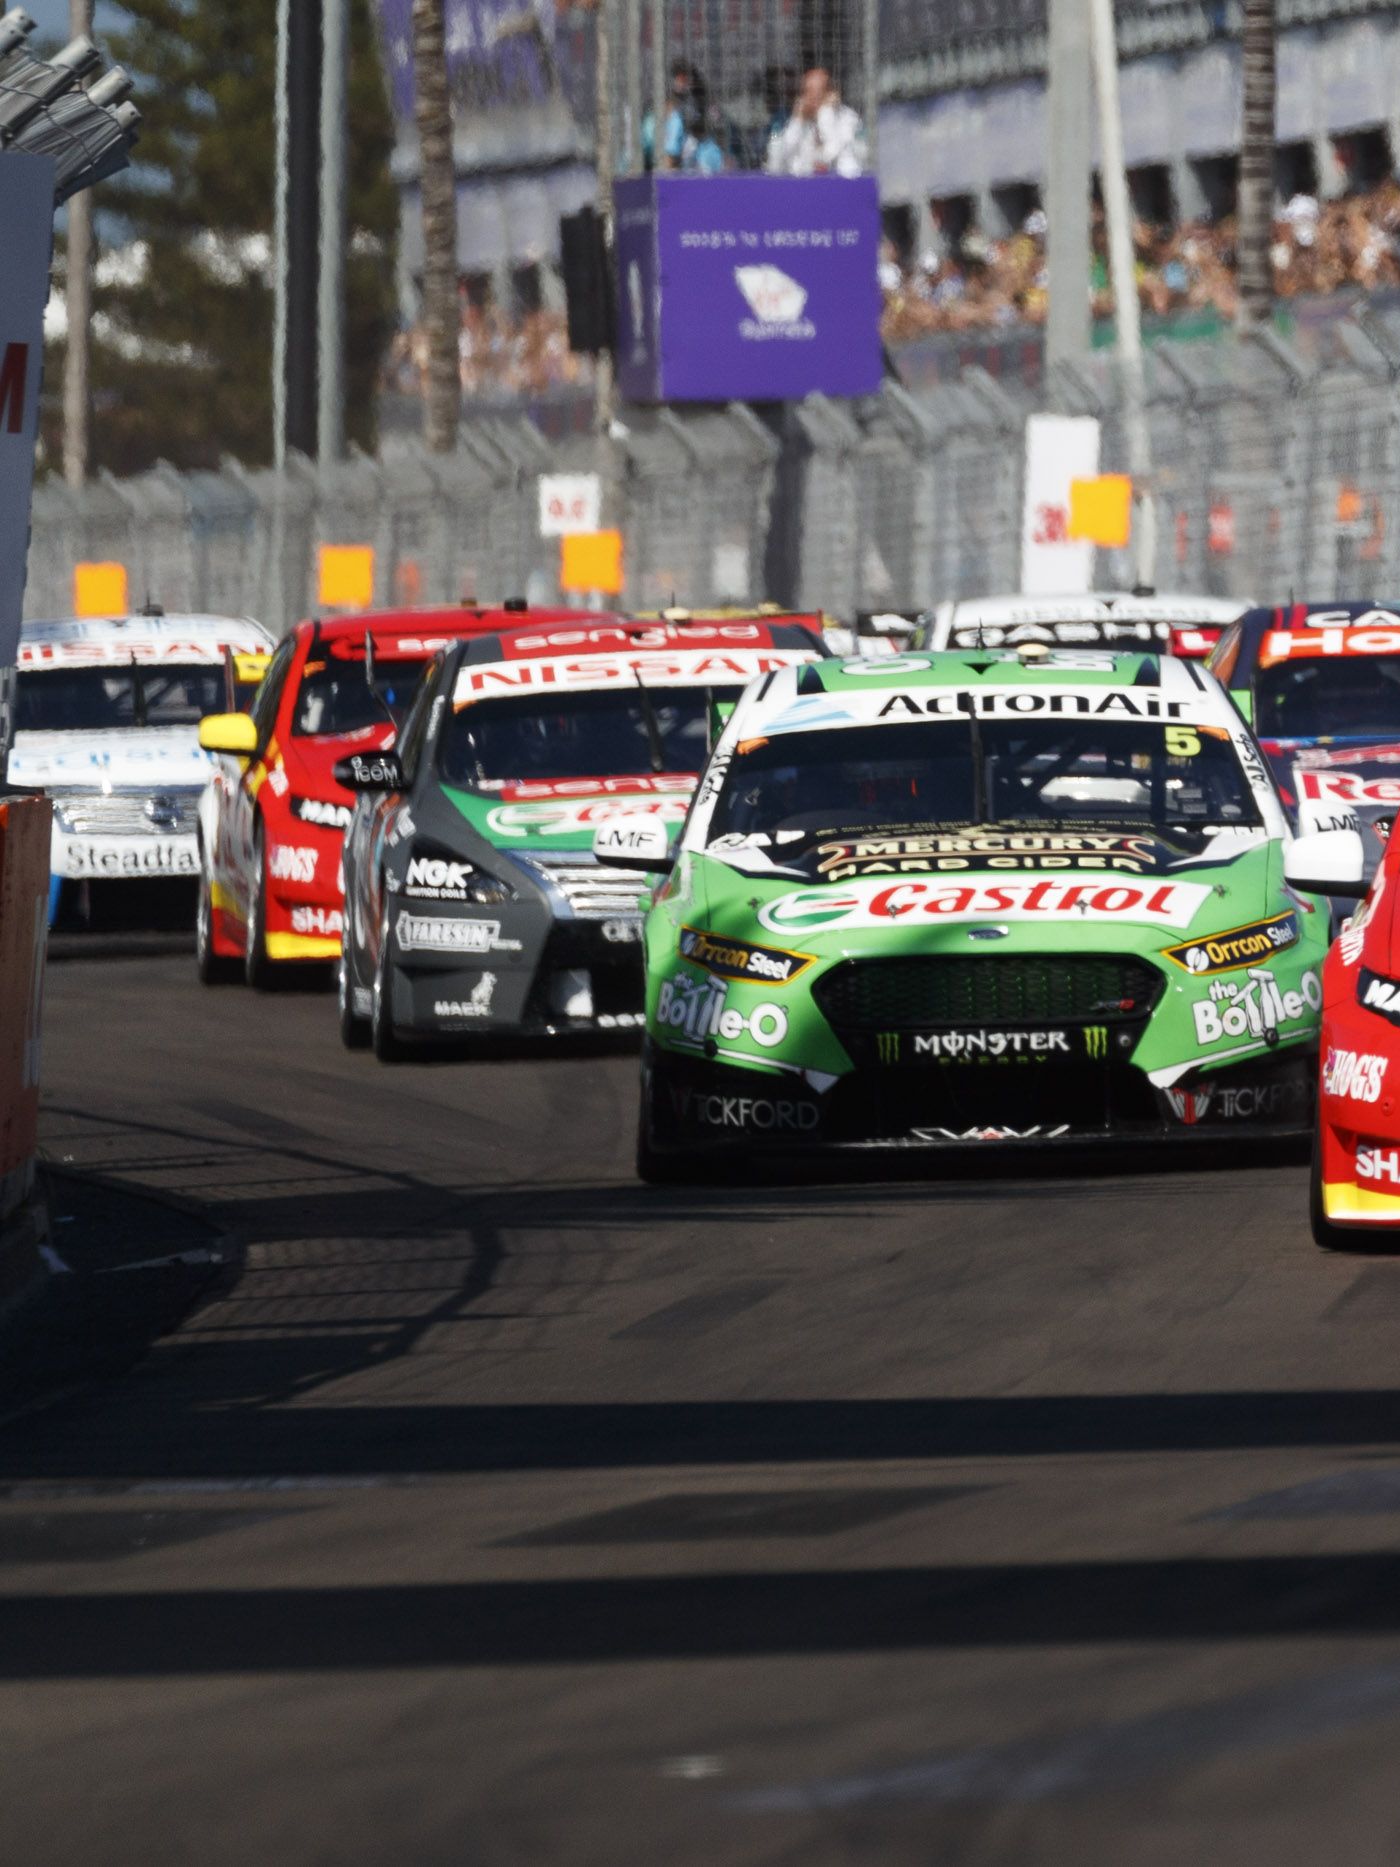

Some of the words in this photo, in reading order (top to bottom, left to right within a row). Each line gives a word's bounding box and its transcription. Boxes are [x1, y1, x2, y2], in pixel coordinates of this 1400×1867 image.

[514, 622, 761, 651] sengled
[876, 691, 1192, 718] ActronAir
[1164, 725, 1202, 757] 5
[514, 776, 699, 797] seng
[597, 830, 657, 848] LMF
[855, 837, 1121, 857] MERCURY
[66, 843, 201, 873] Steadfa
[828, 857, 970, 882] HARD
[987, 857, 1143, 873] CIDER
[405, 857, 474, 889] NGK
[868, 881, 1176, 915] Castrol
[291, 905, 342, 934] SHA
[693, 934, 749, 969] Orrcon
[747, 951, 792, 980] Steel
[1206, 931, 1272, 964] Orrcon
[1267, 921, 1294, 946] Steel
[1208, 979, 1238, 1001] the
[913, 1029, 1070, 1056] MONSTER
[1331, 1050, 1390, 1103] HOGS
